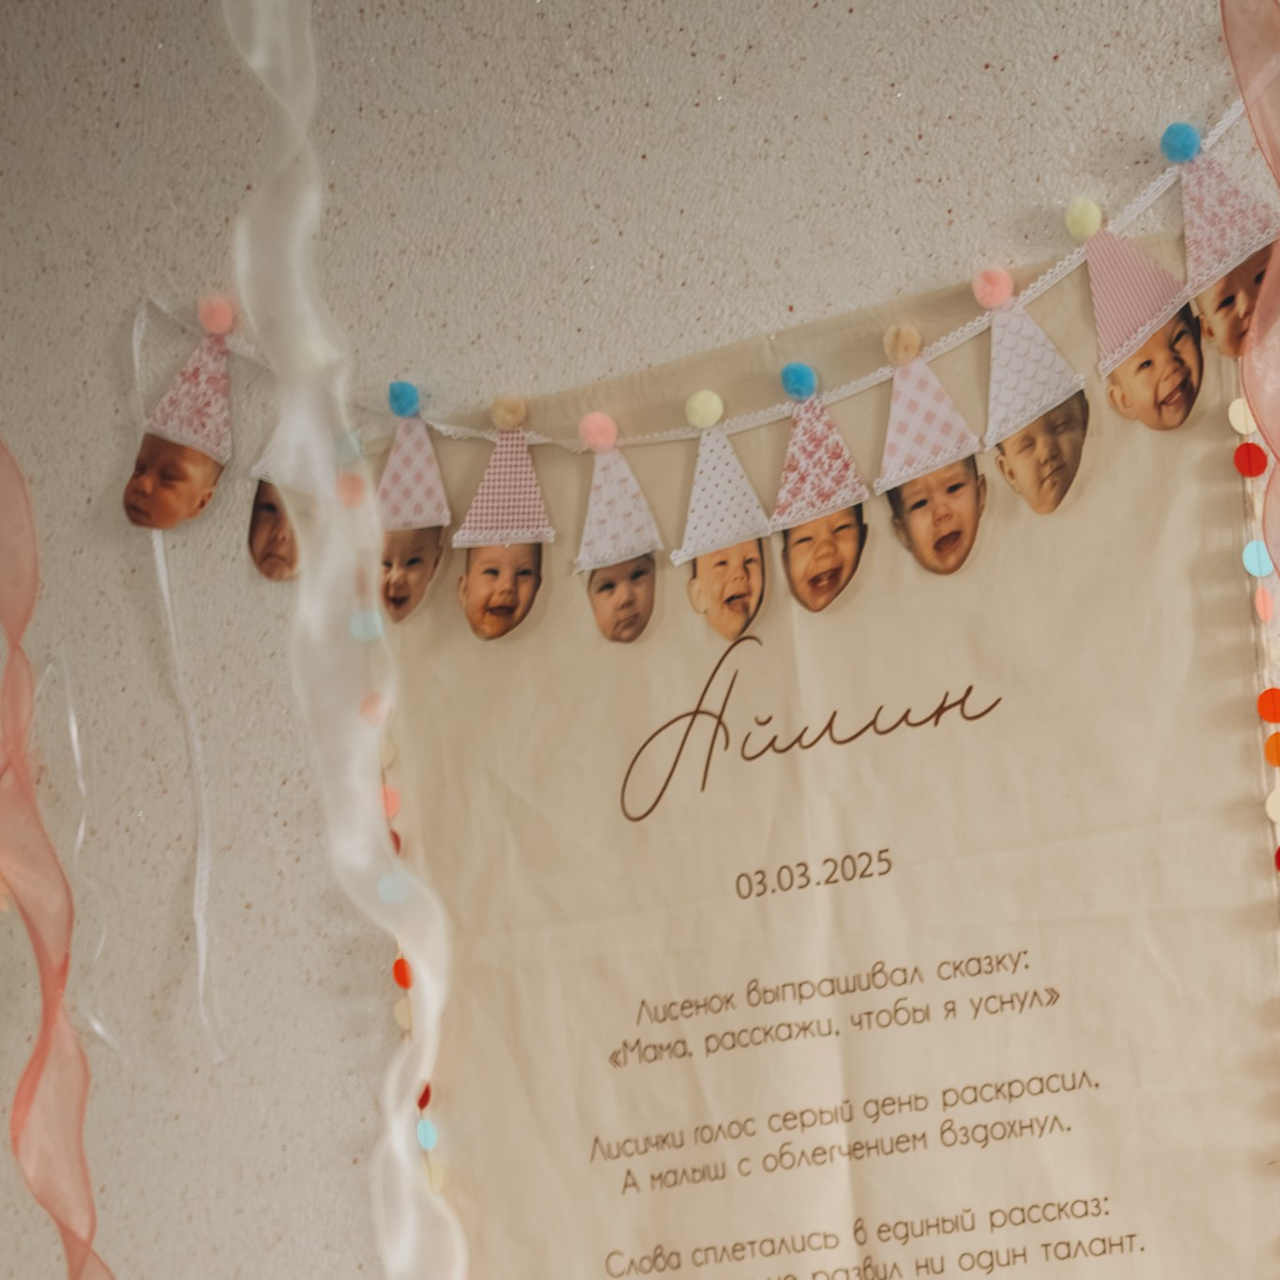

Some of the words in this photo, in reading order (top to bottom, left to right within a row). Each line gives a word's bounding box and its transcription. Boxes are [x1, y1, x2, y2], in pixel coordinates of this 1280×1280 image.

[735, 848, 893, 900] 03.03.2025
[636, 993, 735, 1025] Лисенок
[746, 961, 924, 1007] выпрашивал
[937, 950, 1029, 981] сказку:
[609, 1038, 693, 1067] «Мама,
[850, 997, 930, 1030] чтобы
[944, 1000, 956, 1019] я
[969, 987, 1060, 1020] уснул»
[591, 1131, 684, 1161] Лисички
[694, 1117, 756, 1144] голос
[768, 1099, 854, 1133] серый
[863, 1094, 929, 1124] день
[622, 1169, 640, 1195] А
[650, 1163, 726, 1189] малыш
[738, 1157, 751, 1177] с
[762, 1132, 927, 1173] облегчением
[940, 1115, 1072, 1149] вздохнул.
[605, 1245, 681, 1278] Слова
[691, 1232, 840, 1267] сплетались
[853, 1217, 867, 1246] в
[877, 1208, 976, 1246] единый
[989, 1196, 1109, 1233] рассказ:
[915, 1256, 945, 1276] ни
[958, 1247, 1027, 1275] один
[1040, 1233, 1145, 1261] талант.
